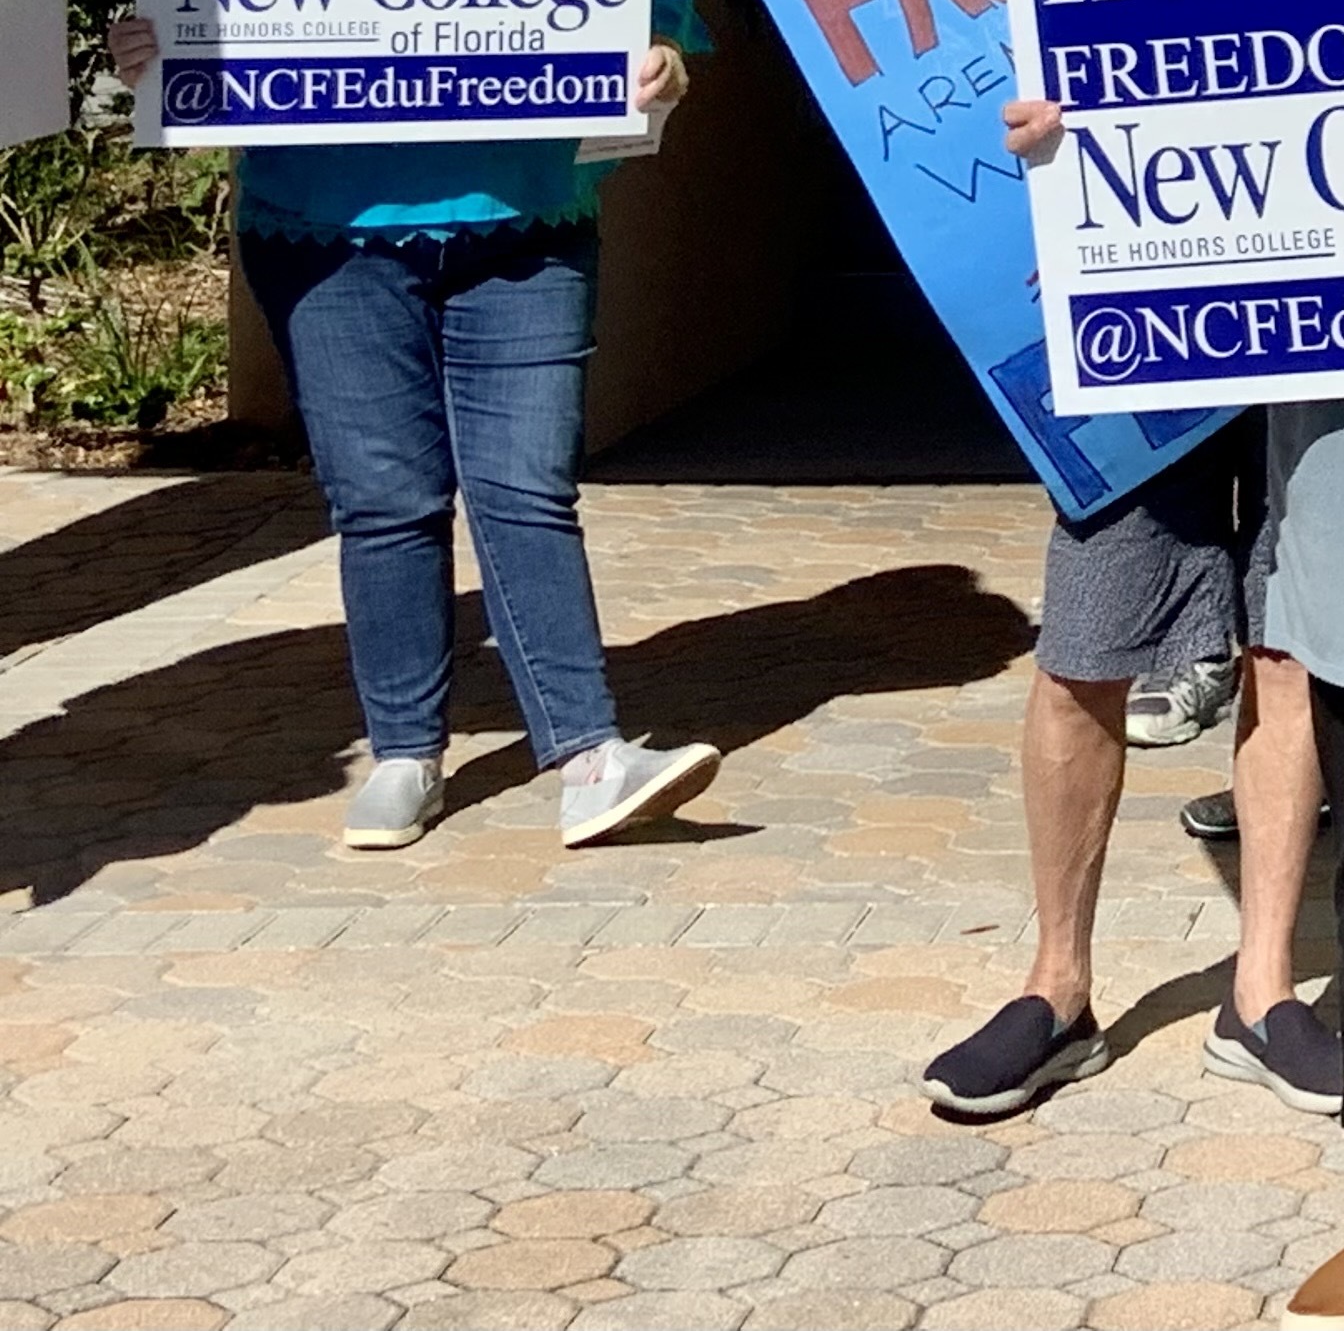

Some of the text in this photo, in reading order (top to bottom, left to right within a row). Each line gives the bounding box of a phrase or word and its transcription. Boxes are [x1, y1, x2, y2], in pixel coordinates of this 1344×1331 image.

[176, 21, 381, 38] THE HONORS COLLEGE
[391, 20, 545, 53] of Florida
[164, 62, 626, 122] @NCFEduFreedom
[1067, 123, 1281, 231] New
[1078, 227, 1336, 265] THE HONORS COLLEGE
